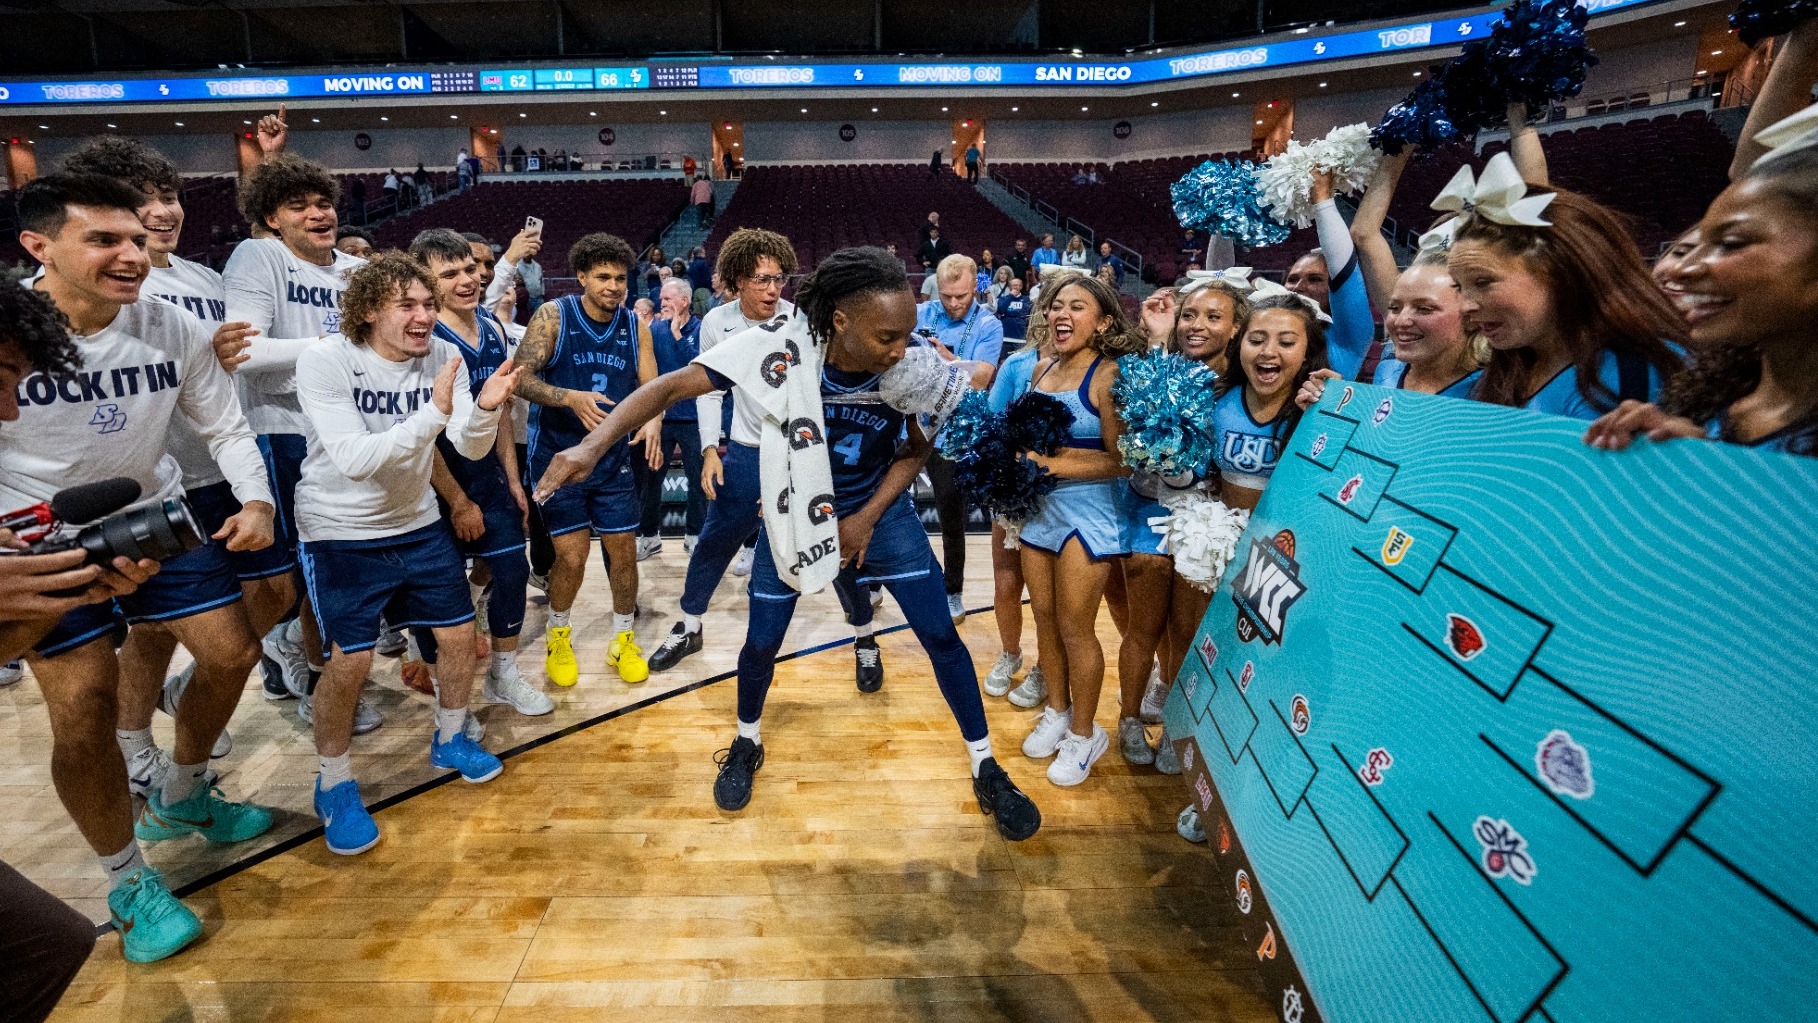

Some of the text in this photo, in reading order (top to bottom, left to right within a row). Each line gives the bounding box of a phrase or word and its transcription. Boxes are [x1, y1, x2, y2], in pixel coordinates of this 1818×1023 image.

[1169, 48, 1267, 75] TOREROS
[510, 75, 527, 88] 62
[554, 70, 573, 81] 0.0
[600, 73, 618, 86] 66
[729, 68, 814, 83] TOREROS
[899, 66, 1001, 81] MOVING ON
[1035, 66, 1131, 80] SAN DIEGO
[41, 84, 124, 99] TOREROS
[206, 79, 288, 96] TOREROS
[324, 76, 424, 92] MOVING ON
[288, 281, 335, 308] LOCK
[573, 351, 626, 370] SAN DIEGO
[14, 370, 108, 407] LOCK
[111, 366, 140, 398] IT
[934, 365, 958, 413] GAMETIME
[353, 387, 403, 415] LOCK
[842, 406, 888, 431] DIEGO
[1242, 544, 1301, 636] WCC
